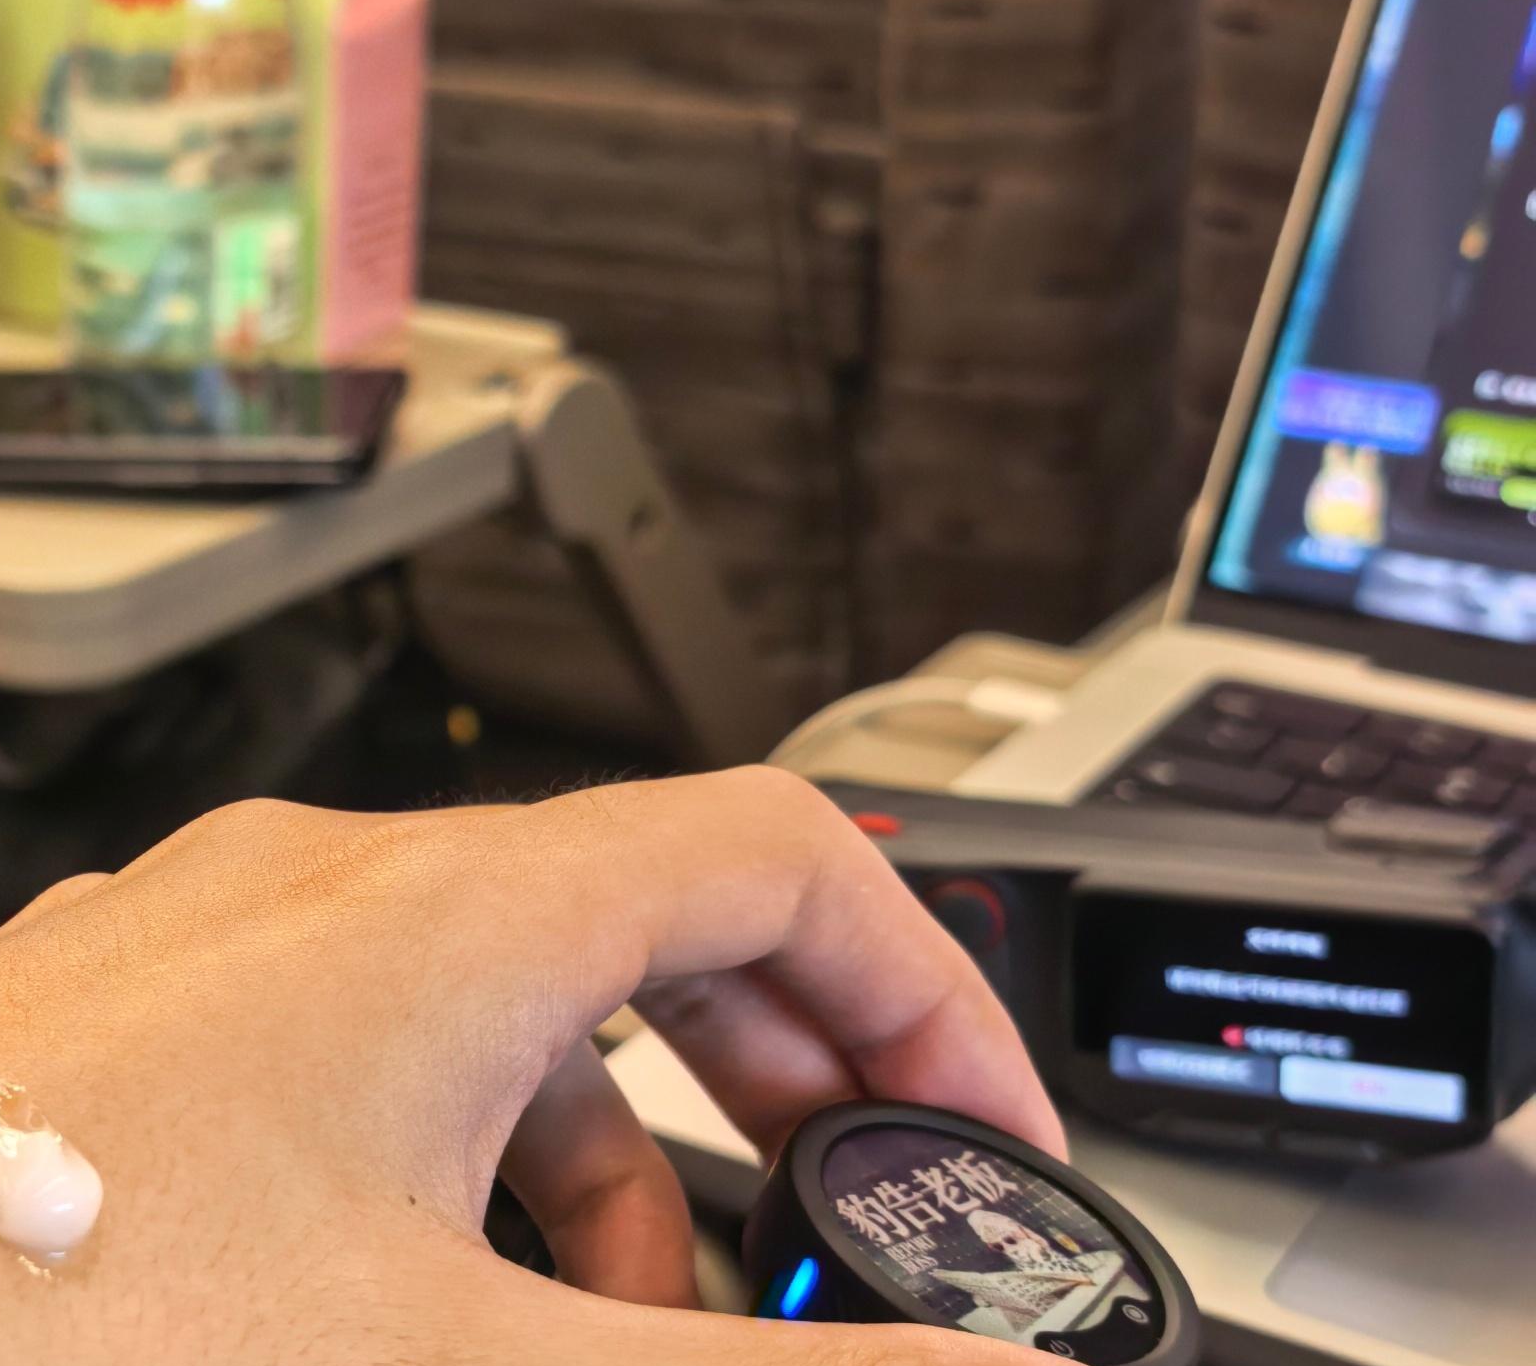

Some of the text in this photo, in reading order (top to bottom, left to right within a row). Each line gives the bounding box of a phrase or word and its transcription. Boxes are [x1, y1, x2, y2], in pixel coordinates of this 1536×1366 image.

[836, 1150, 1019, 1245] 豹告老板
[884, 1233, 938, 1260] REPORT
